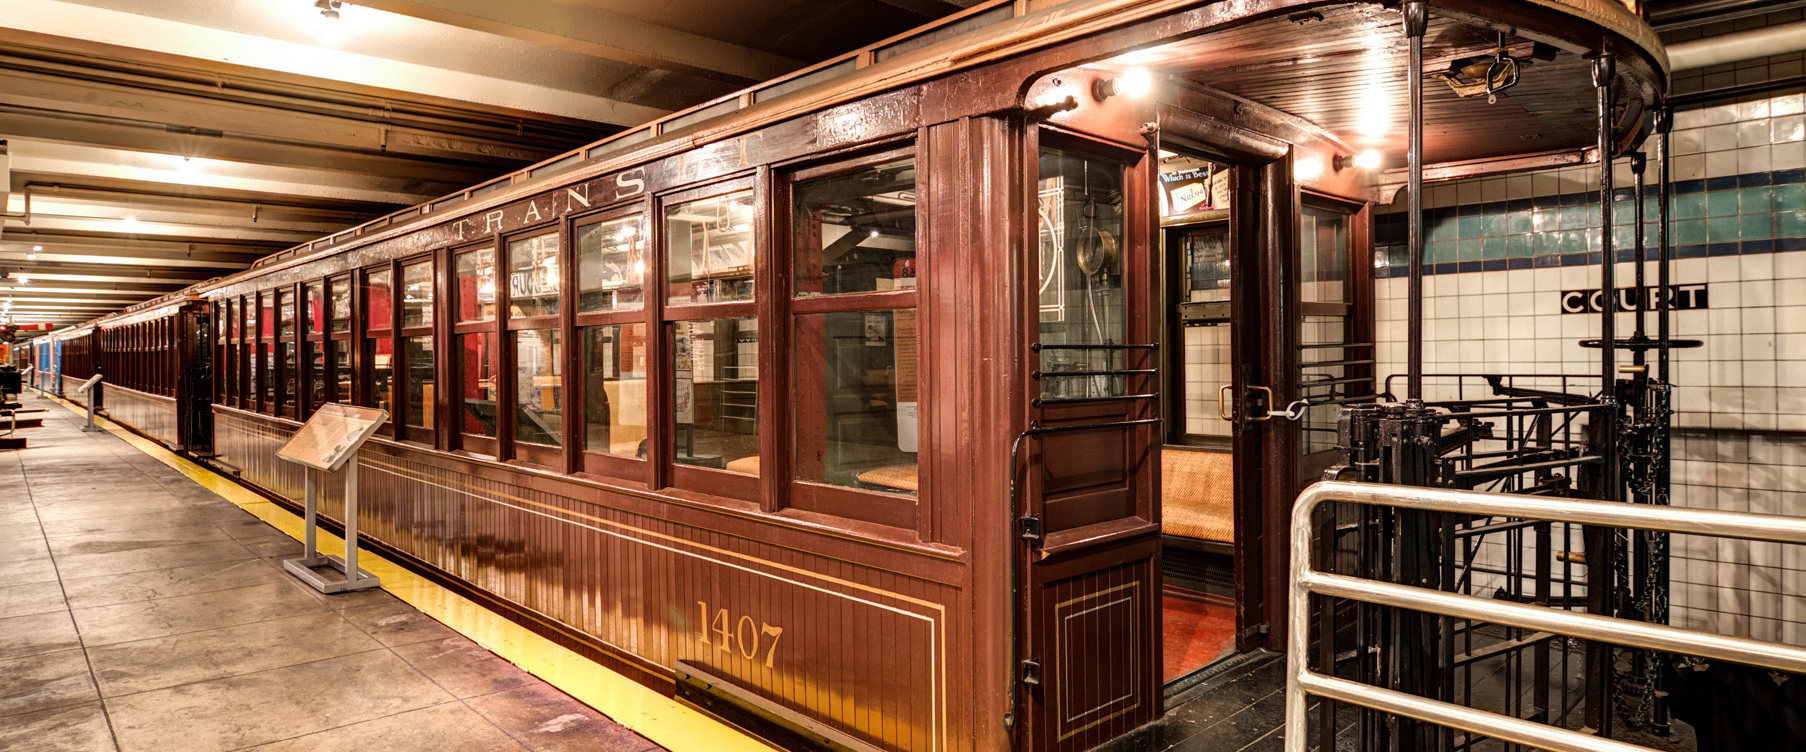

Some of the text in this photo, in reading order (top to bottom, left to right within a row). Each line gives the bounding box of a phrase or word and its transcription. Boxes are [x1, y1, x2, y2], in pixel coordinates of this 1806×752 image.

[1160, 173, 1184, 182] Which
[1180, 189, 1204, 203] Nucoa
[1562, 285, 1706, 313] COURT
[697, 600, 783, 669] 1407
